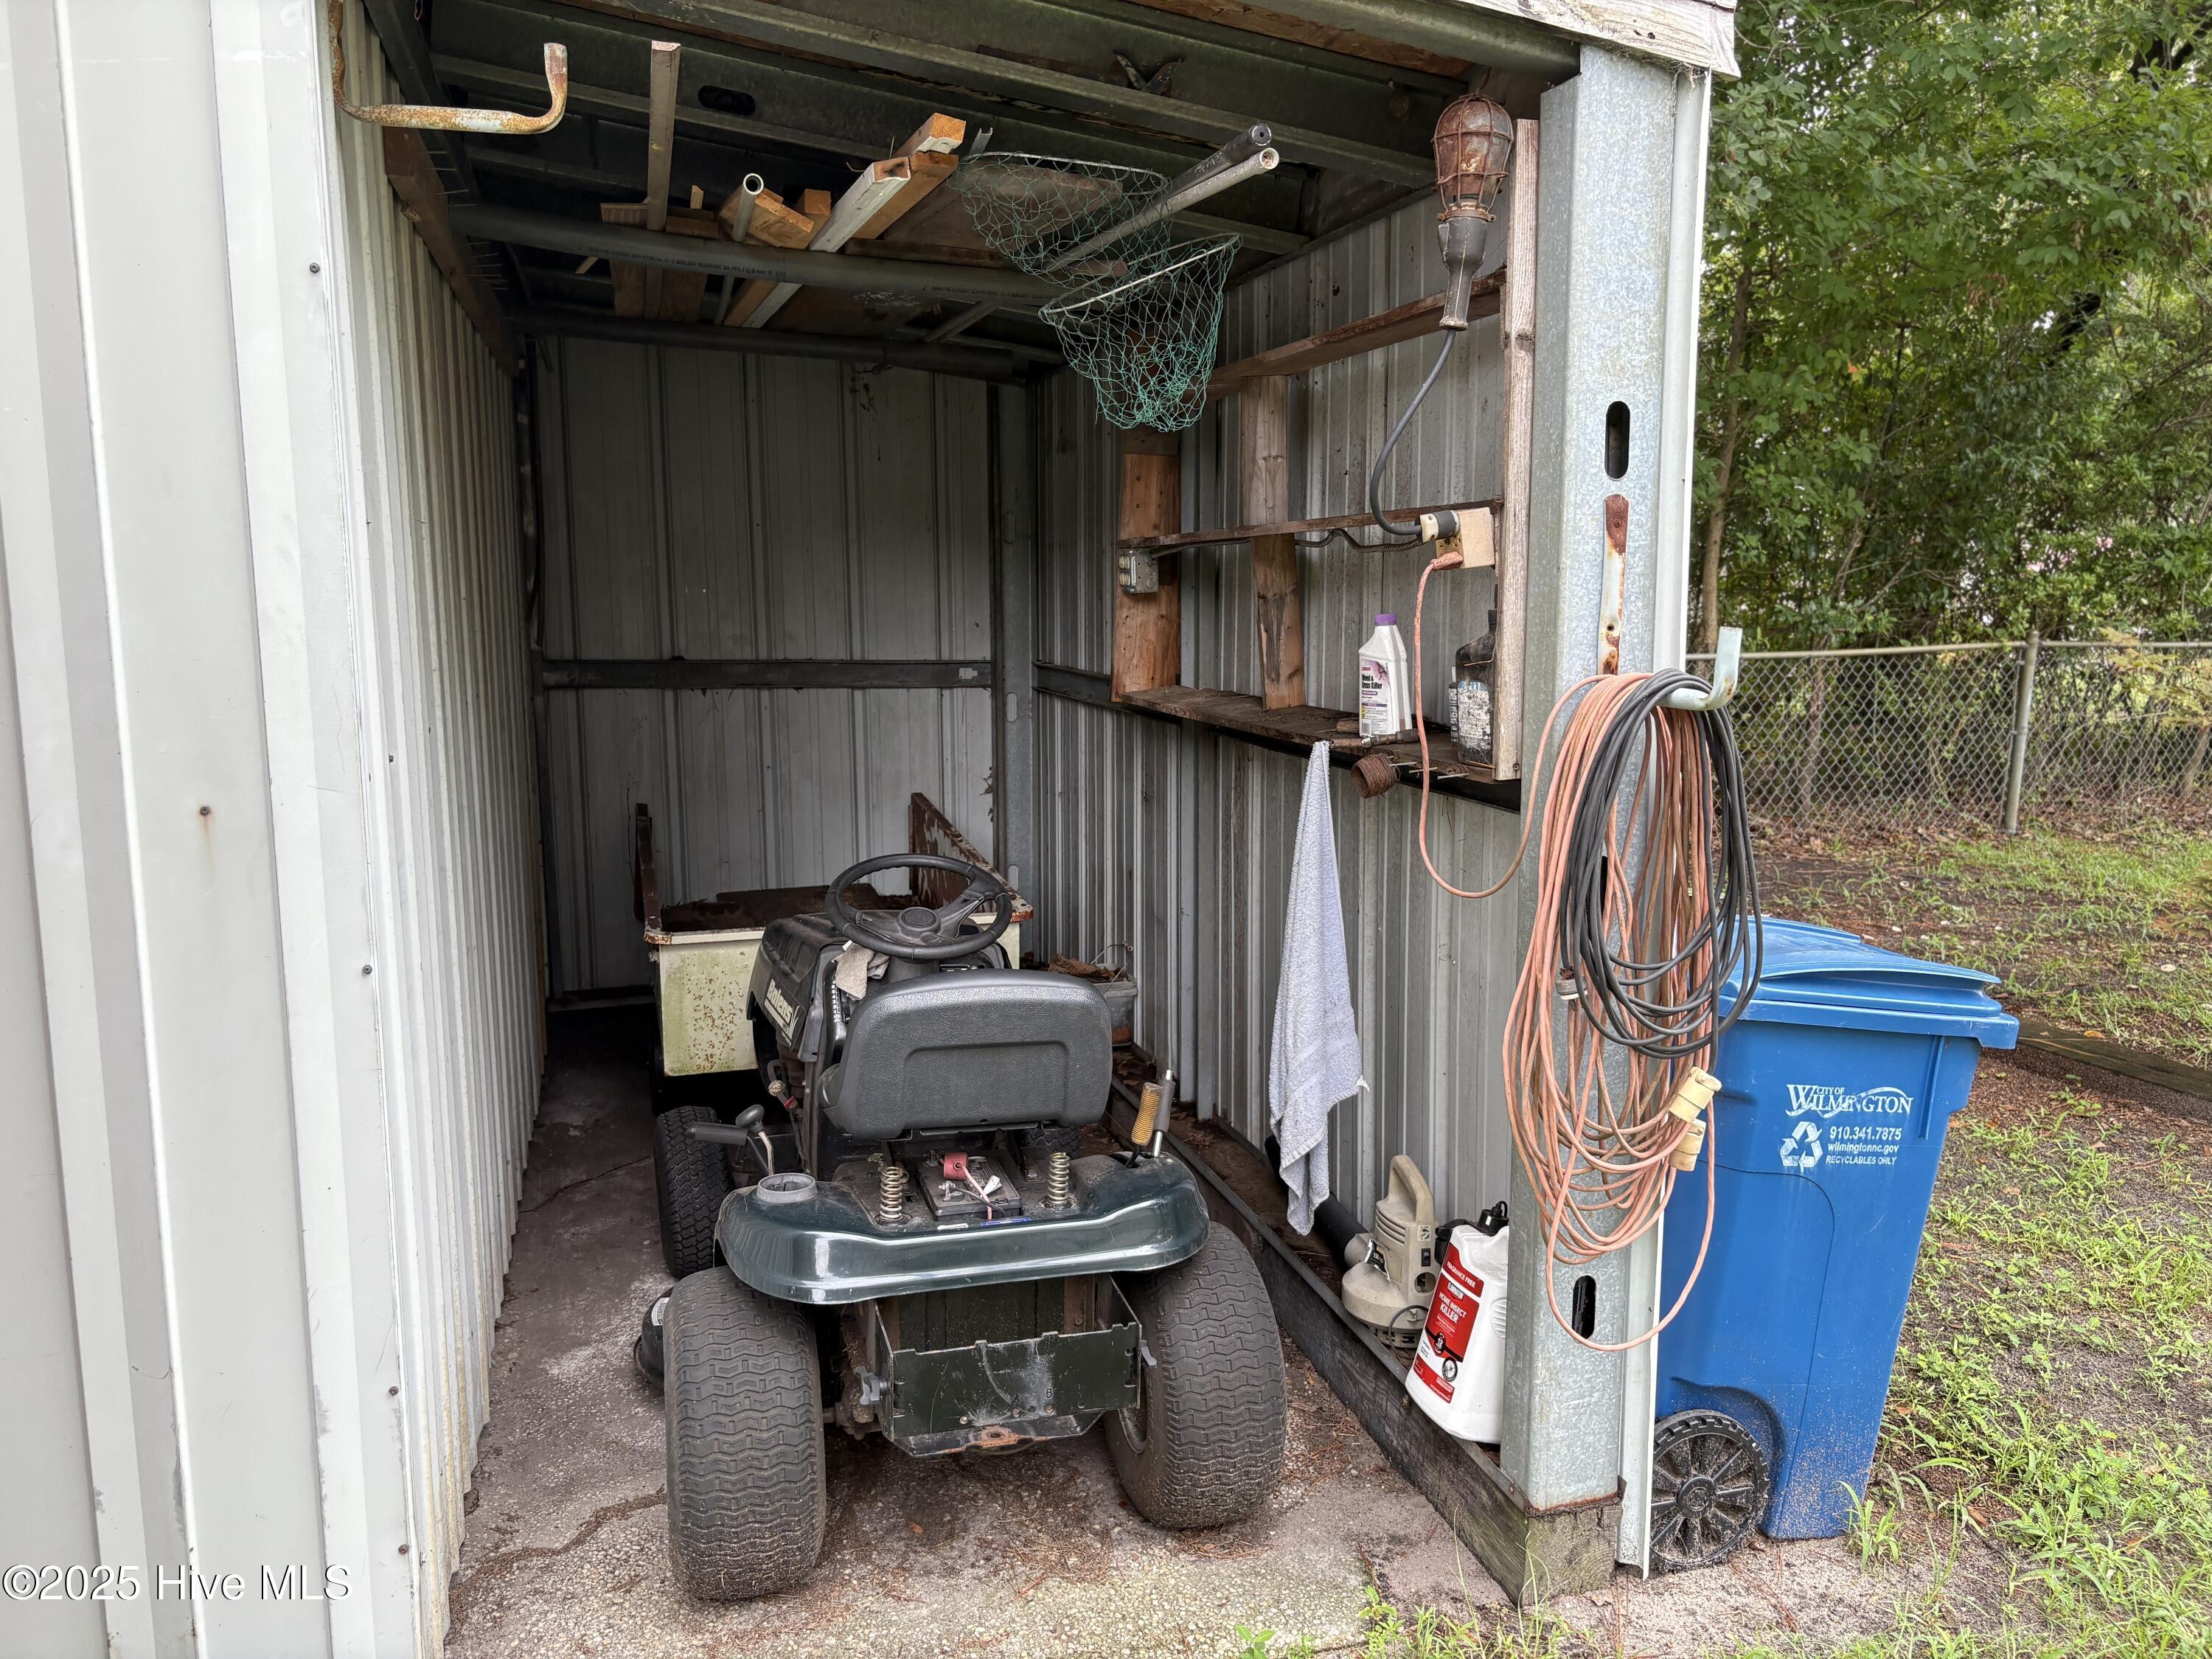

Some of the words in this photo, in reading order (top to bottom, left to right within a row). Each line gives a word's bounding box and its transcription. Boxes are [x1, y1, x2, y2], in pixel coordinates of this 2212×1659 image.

[1816, 1086, 1833, 1094] CITY
[1829, 1126, 1902, 1141] 910.341.7875
[1828, 1141, 1899, 1155] wilmingtonnc.gov
[1826, 1155, 1877, 1165] RECYCLABLES
[1464, 1276, 1476, 1289] FREE
[1439, 1291, 1450, 1307] HOME
[1450, 1301, 1467, 1318] INSECT
[1440, 1302, 1459, 1324] KILLER
